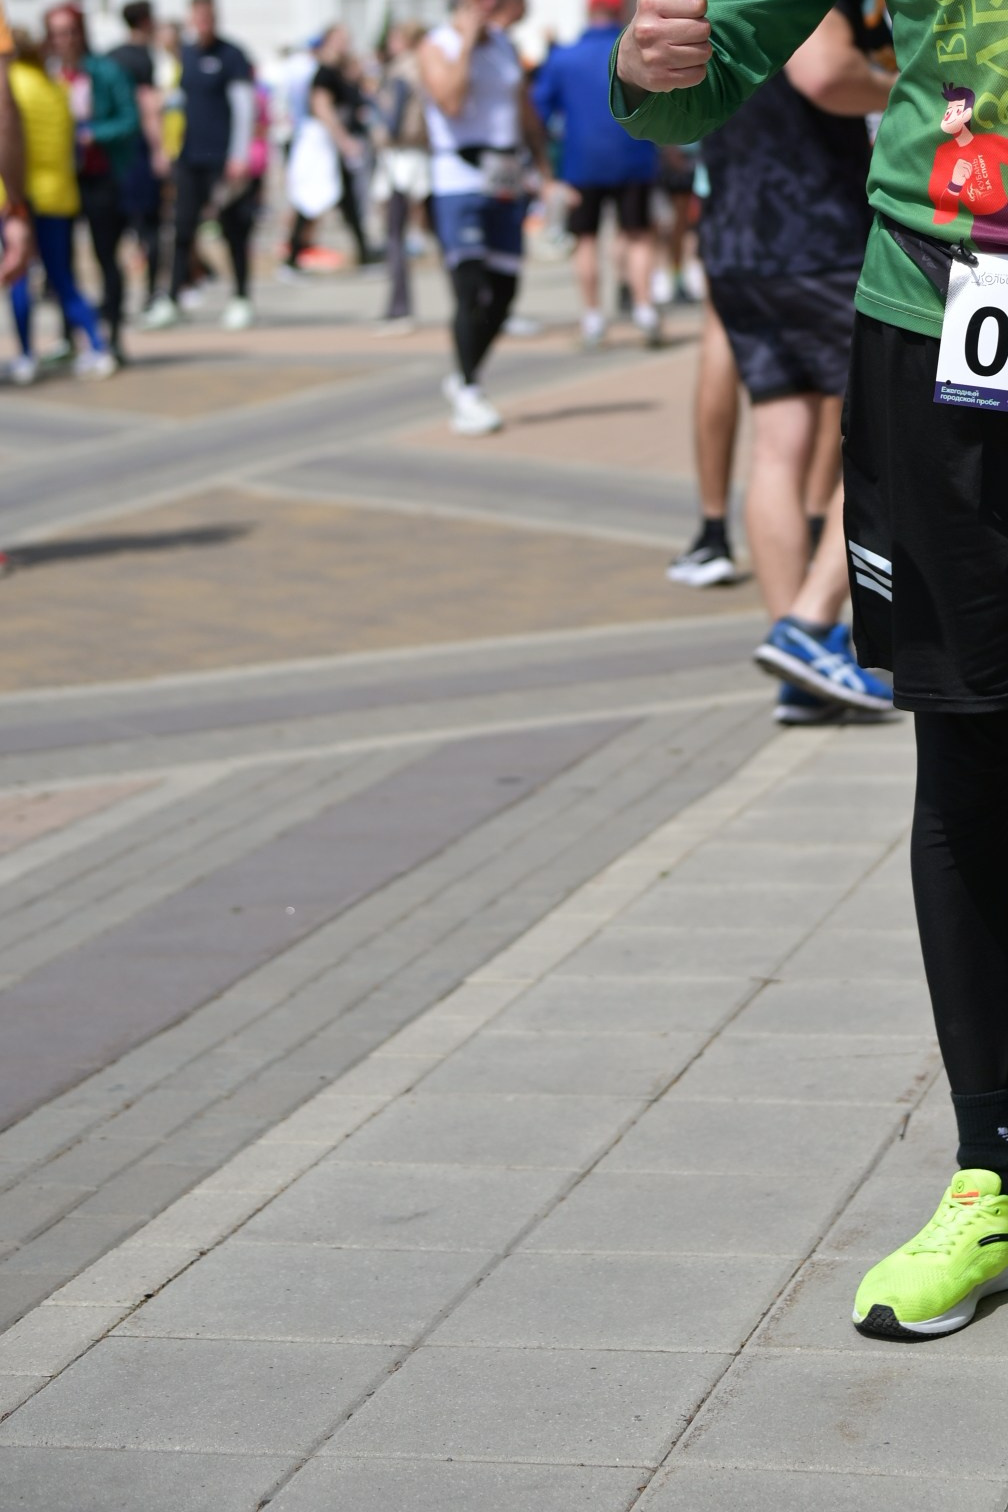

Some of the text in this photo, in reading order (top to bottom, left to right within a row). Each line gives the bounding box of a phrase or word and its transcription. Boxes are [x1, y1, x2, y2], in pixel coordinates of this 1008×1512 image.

[973, 158, 985, 191] КУБАНЬ
[977, 154, 992, 190] ЗА СПОРТ
[940, 394, 1001, 406] городской пробег
[941, 386, 979, 397] Ежегодный
